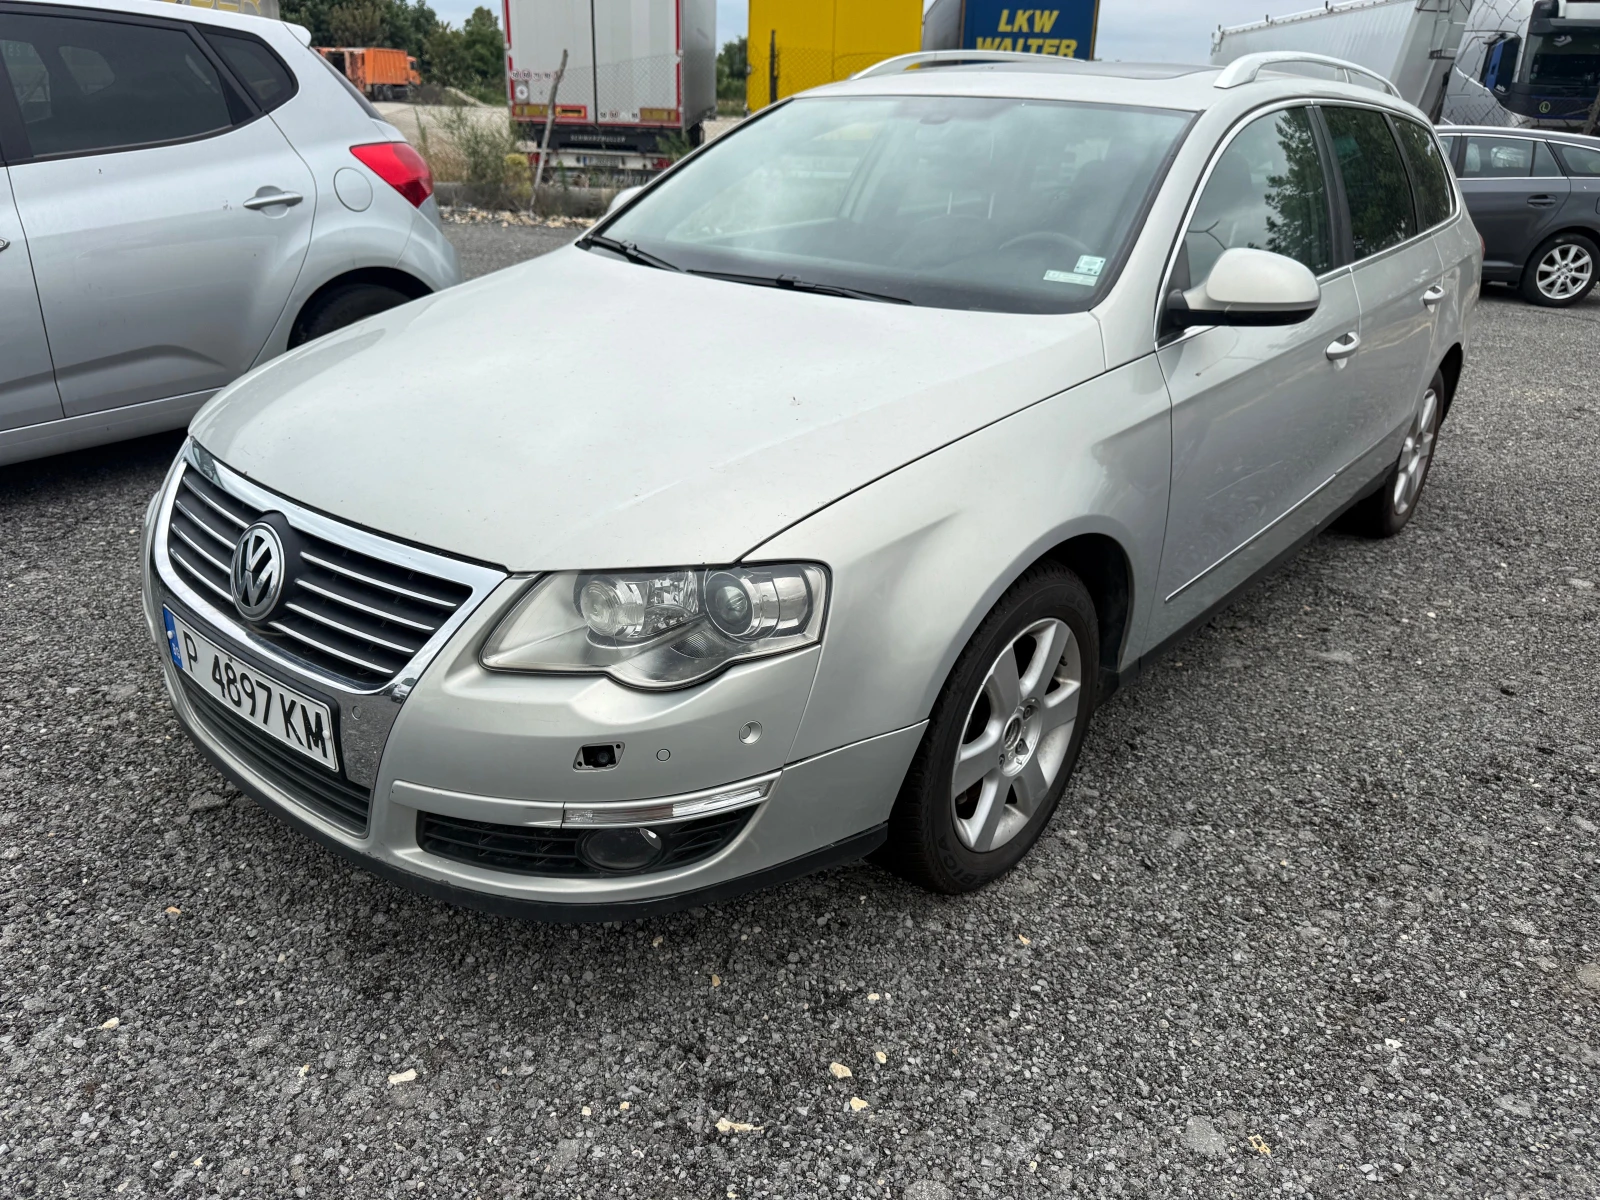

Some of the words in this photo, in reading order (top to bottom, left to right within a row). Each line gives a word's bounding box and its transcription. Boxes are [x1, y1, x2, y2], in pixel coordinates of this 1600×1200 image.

[997, 9, 1060, 33] LKW
[183, 630, 198, 673] P
[212, 654, 272, 725] 4897
[279, 692, 328, 759] KM
